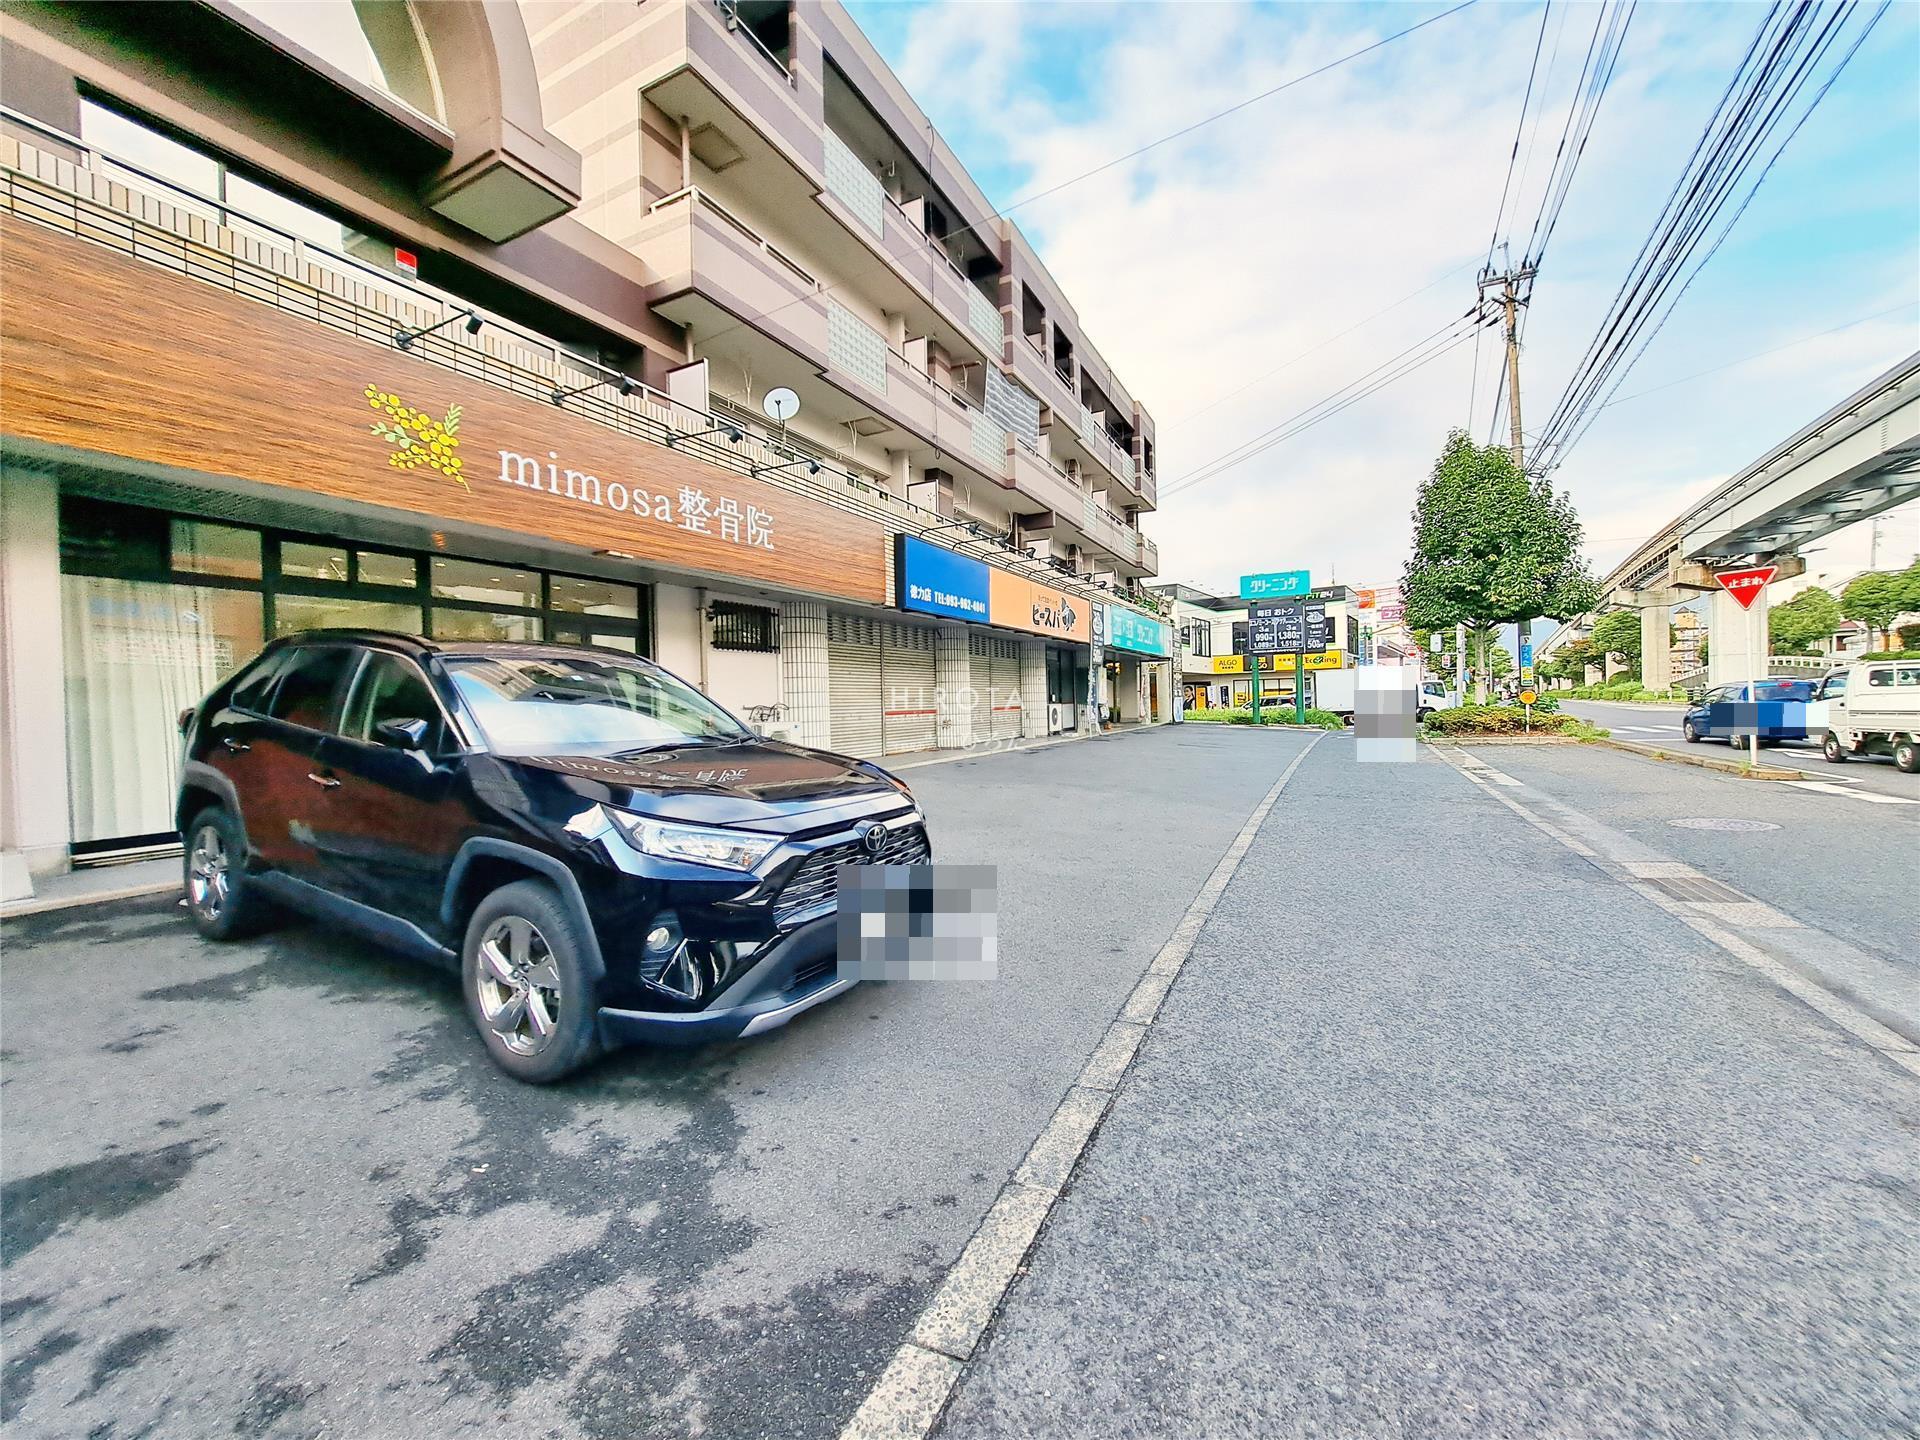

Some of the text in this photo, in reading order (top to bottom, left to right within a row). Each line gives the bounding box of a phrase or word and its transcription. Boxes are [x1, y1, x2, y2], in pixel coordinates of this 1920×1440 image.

[1250, 577, 1299, 592] クリーニング
[1727, 577, 1764, 588] 止まれ
[1274, 608, 1294, 616] おトク
[1218, 659, 1238, 667] ALGO
